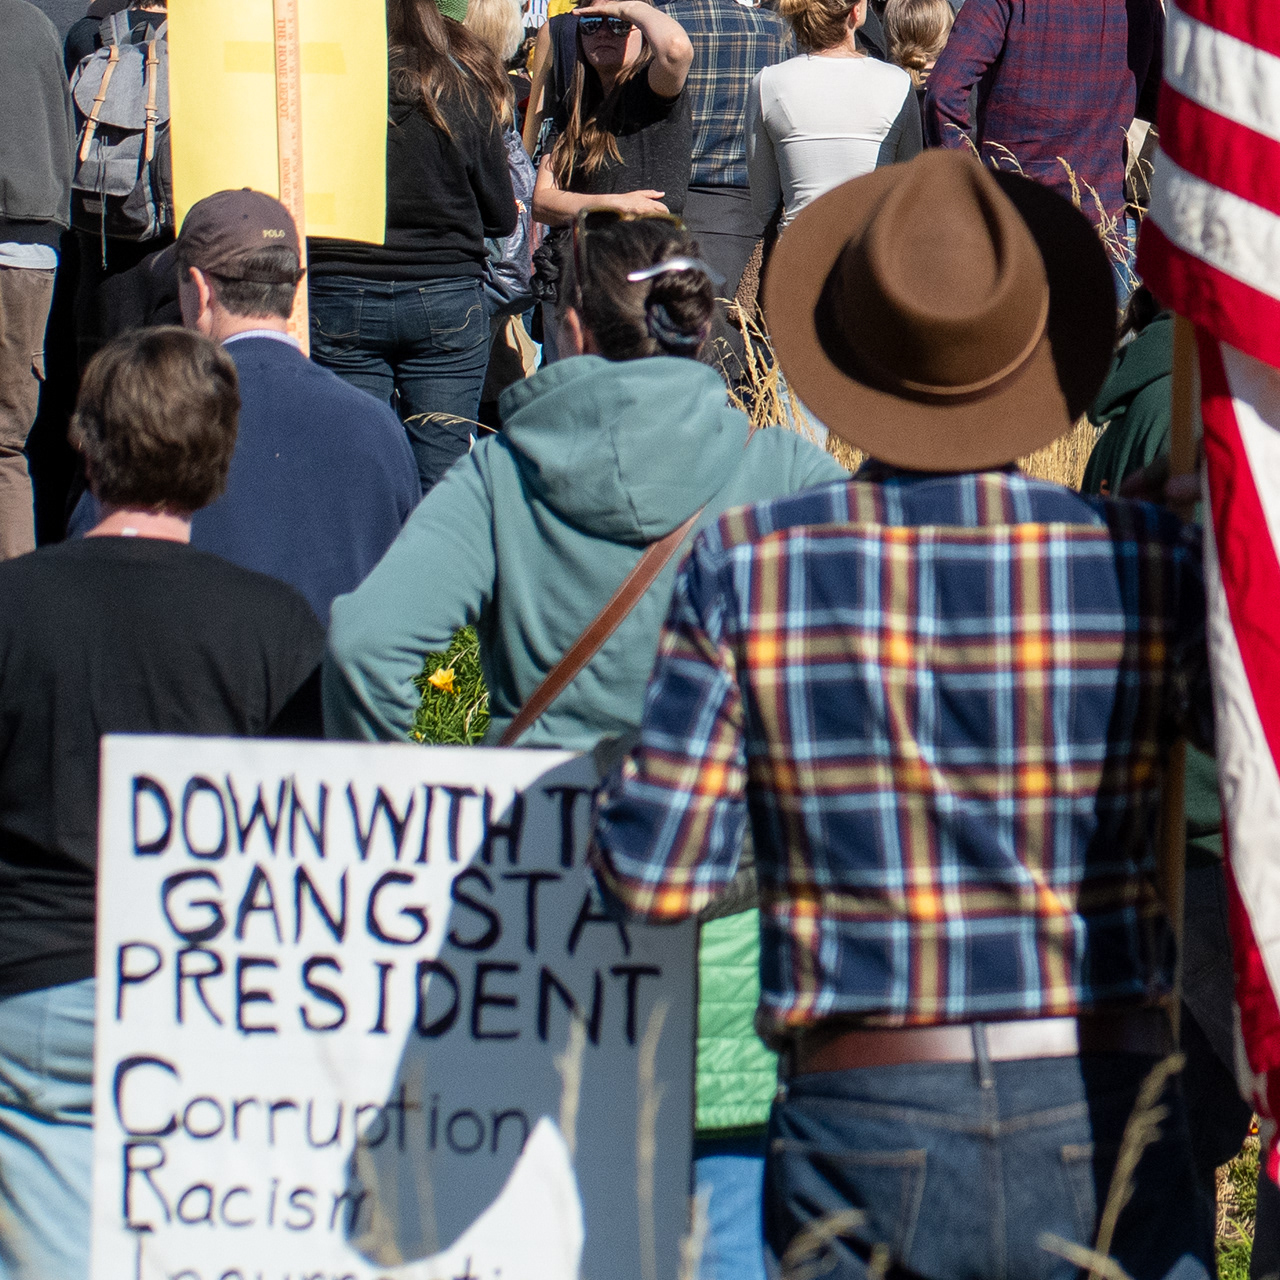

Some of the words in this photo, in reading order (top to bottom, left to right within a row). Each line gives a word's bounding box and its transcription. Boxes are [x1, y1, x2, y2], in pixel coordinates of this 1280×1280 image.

[131, 773, 330, 861] DOWN
[346, 780, 526, 868] WITH
[115, 939, 662, 1046] PRESIDENT
[112, 1054, 534, 1156] Corruption
